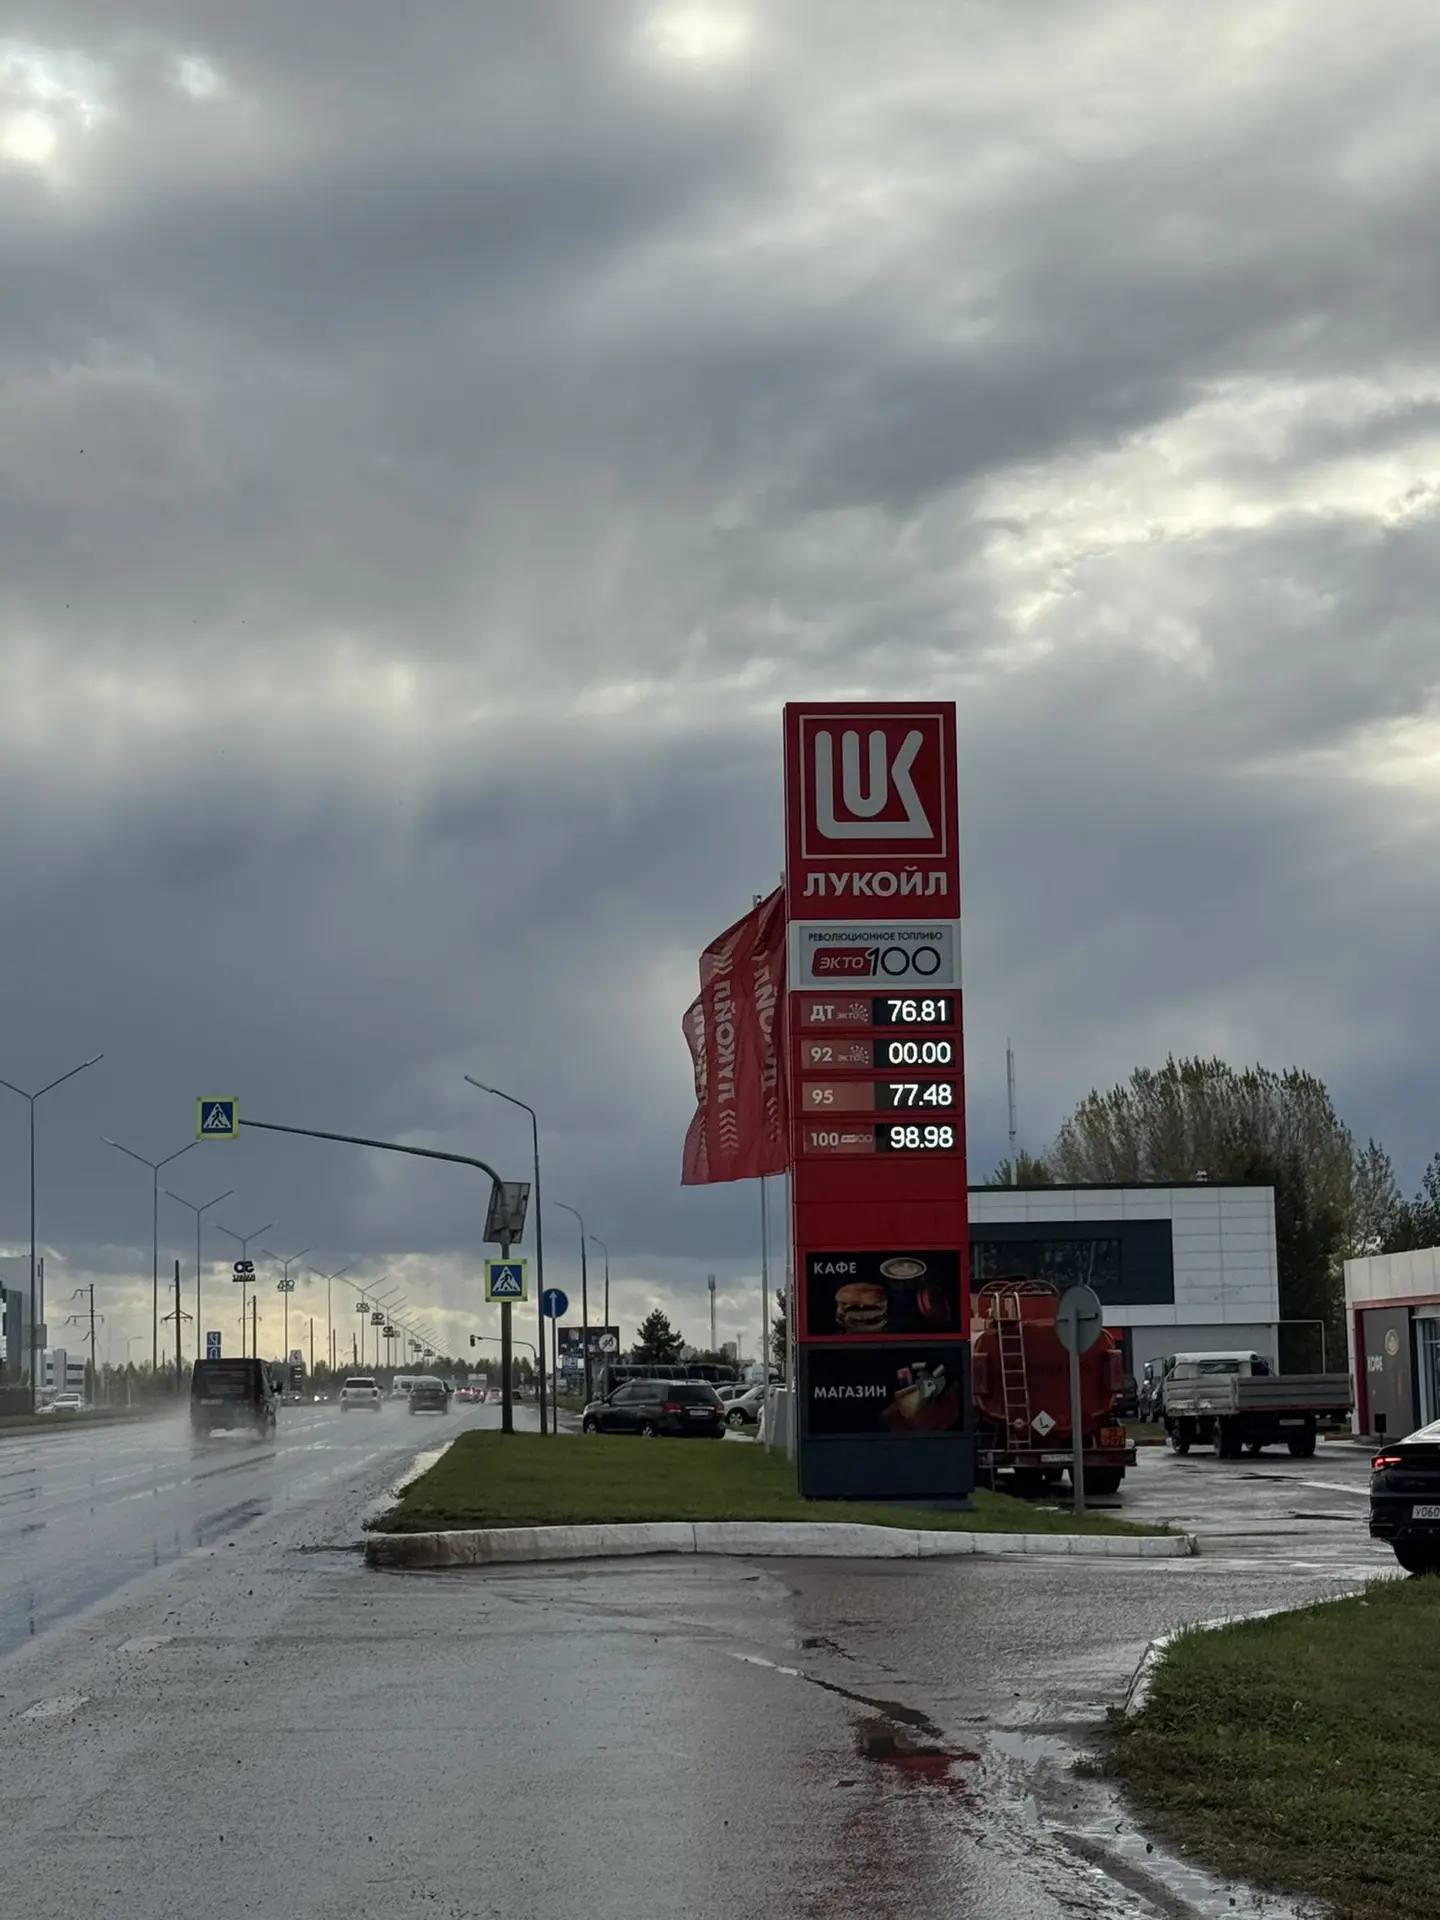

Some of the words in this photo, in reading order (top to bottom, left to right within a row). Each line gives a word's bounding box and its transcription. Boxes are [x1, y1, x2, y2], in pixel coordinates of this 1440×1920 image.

[803, 865, 948, 897] ЛУКОЙЛ
[808, 932, 896, 942] РЕВОЛЮЦИОННОЕ
[897, 931, 943, 941] ТОПЛИВО
[810, 1005, 835, 1023] ДТ
[888, 1000, 948, 1022] 76.81
[810, 1046, 833, 1062] 92
[888, 1042, 952, 1065] 00.00
[812, 1089, 835, 1105] 95
[889, 1083, 953, 1107] 77.48
[811, 1132, 839, 1147] 100
[890, 1126, 954, 1149] 98.98
[813, 1262, 857, 1274] КАФЕ
[814, 1385, 887, 1399] МАГАЗИН
